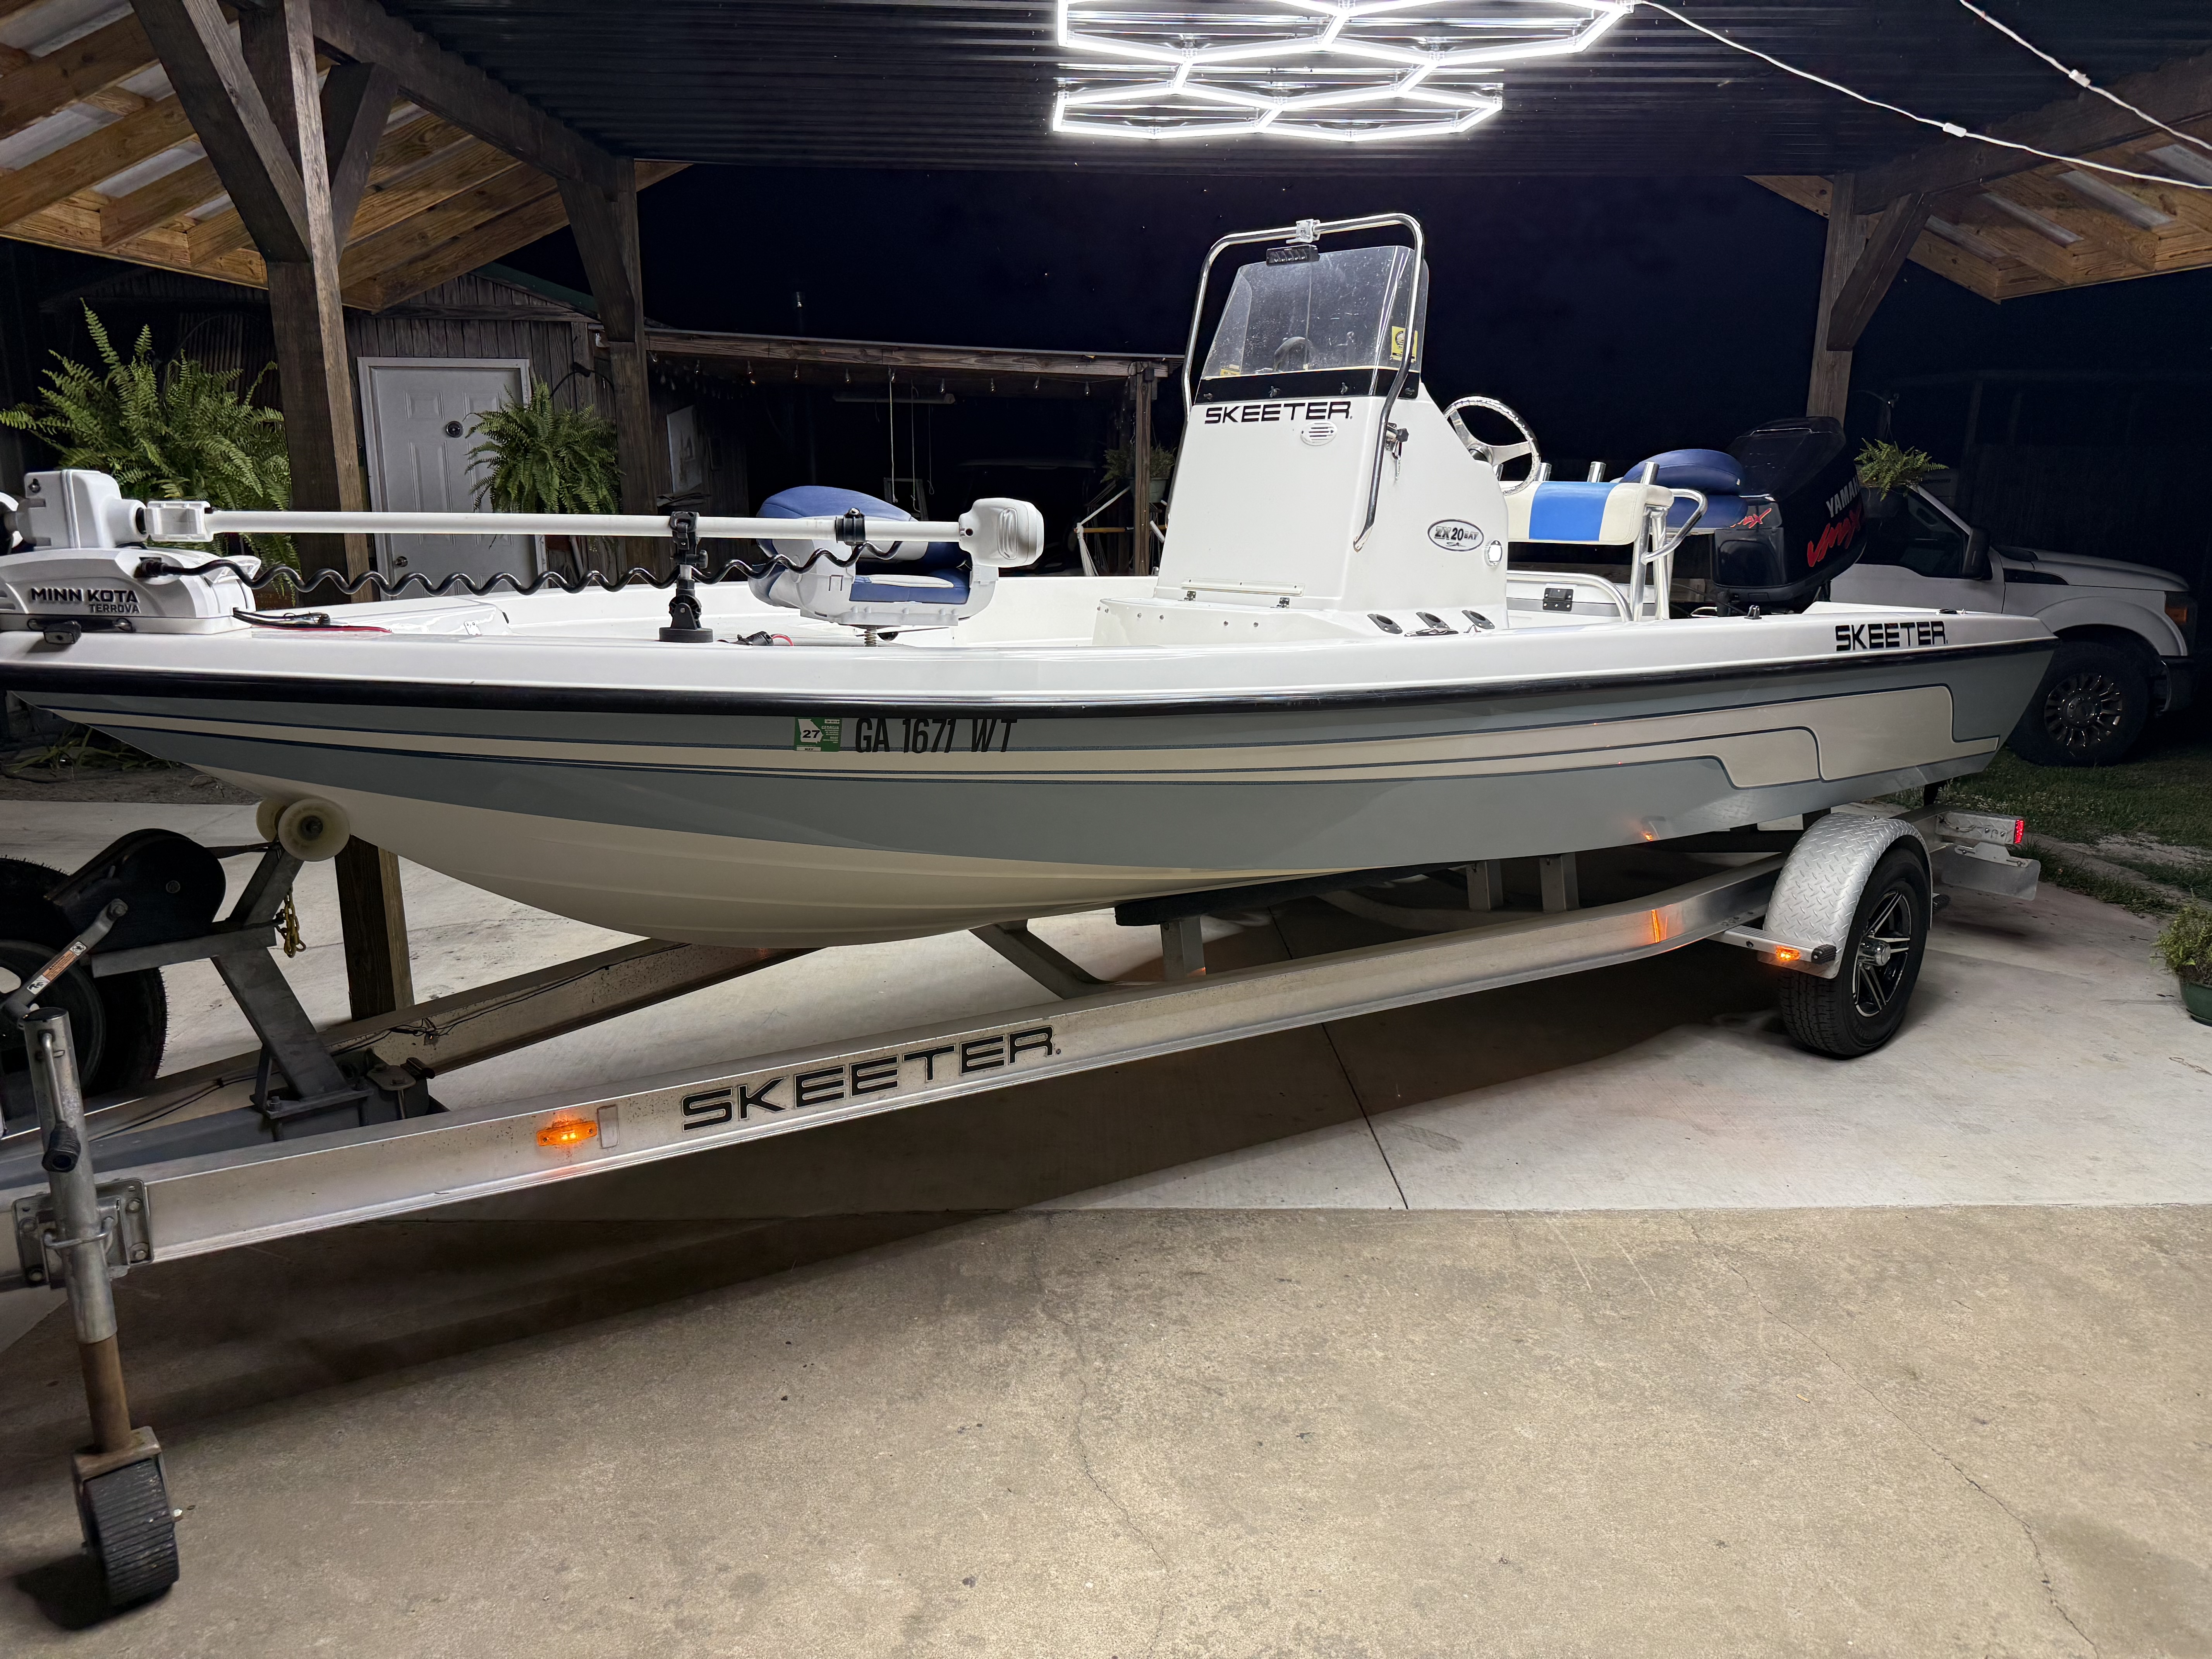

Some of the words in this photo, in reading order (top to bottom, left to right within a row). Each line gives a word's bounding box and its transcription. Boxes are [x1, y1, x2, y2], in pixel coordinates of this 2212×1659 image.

[1205, 401, 1352, 424] SKEETER
[1826, 474, 1859, 518] YAMAH
[31, 587, 84, 601] MINN
[87, 589, 140, 603] KOTA
[89, 604, 141, 614] TERROVA
[1836, 621, 1946, 651] SKEETER
[802, 730, 820, 738] 27
[855, 718, 890, 752] GA
[902, 718, 957, 753] 1671
[971, 718, 1017, 752] WT
